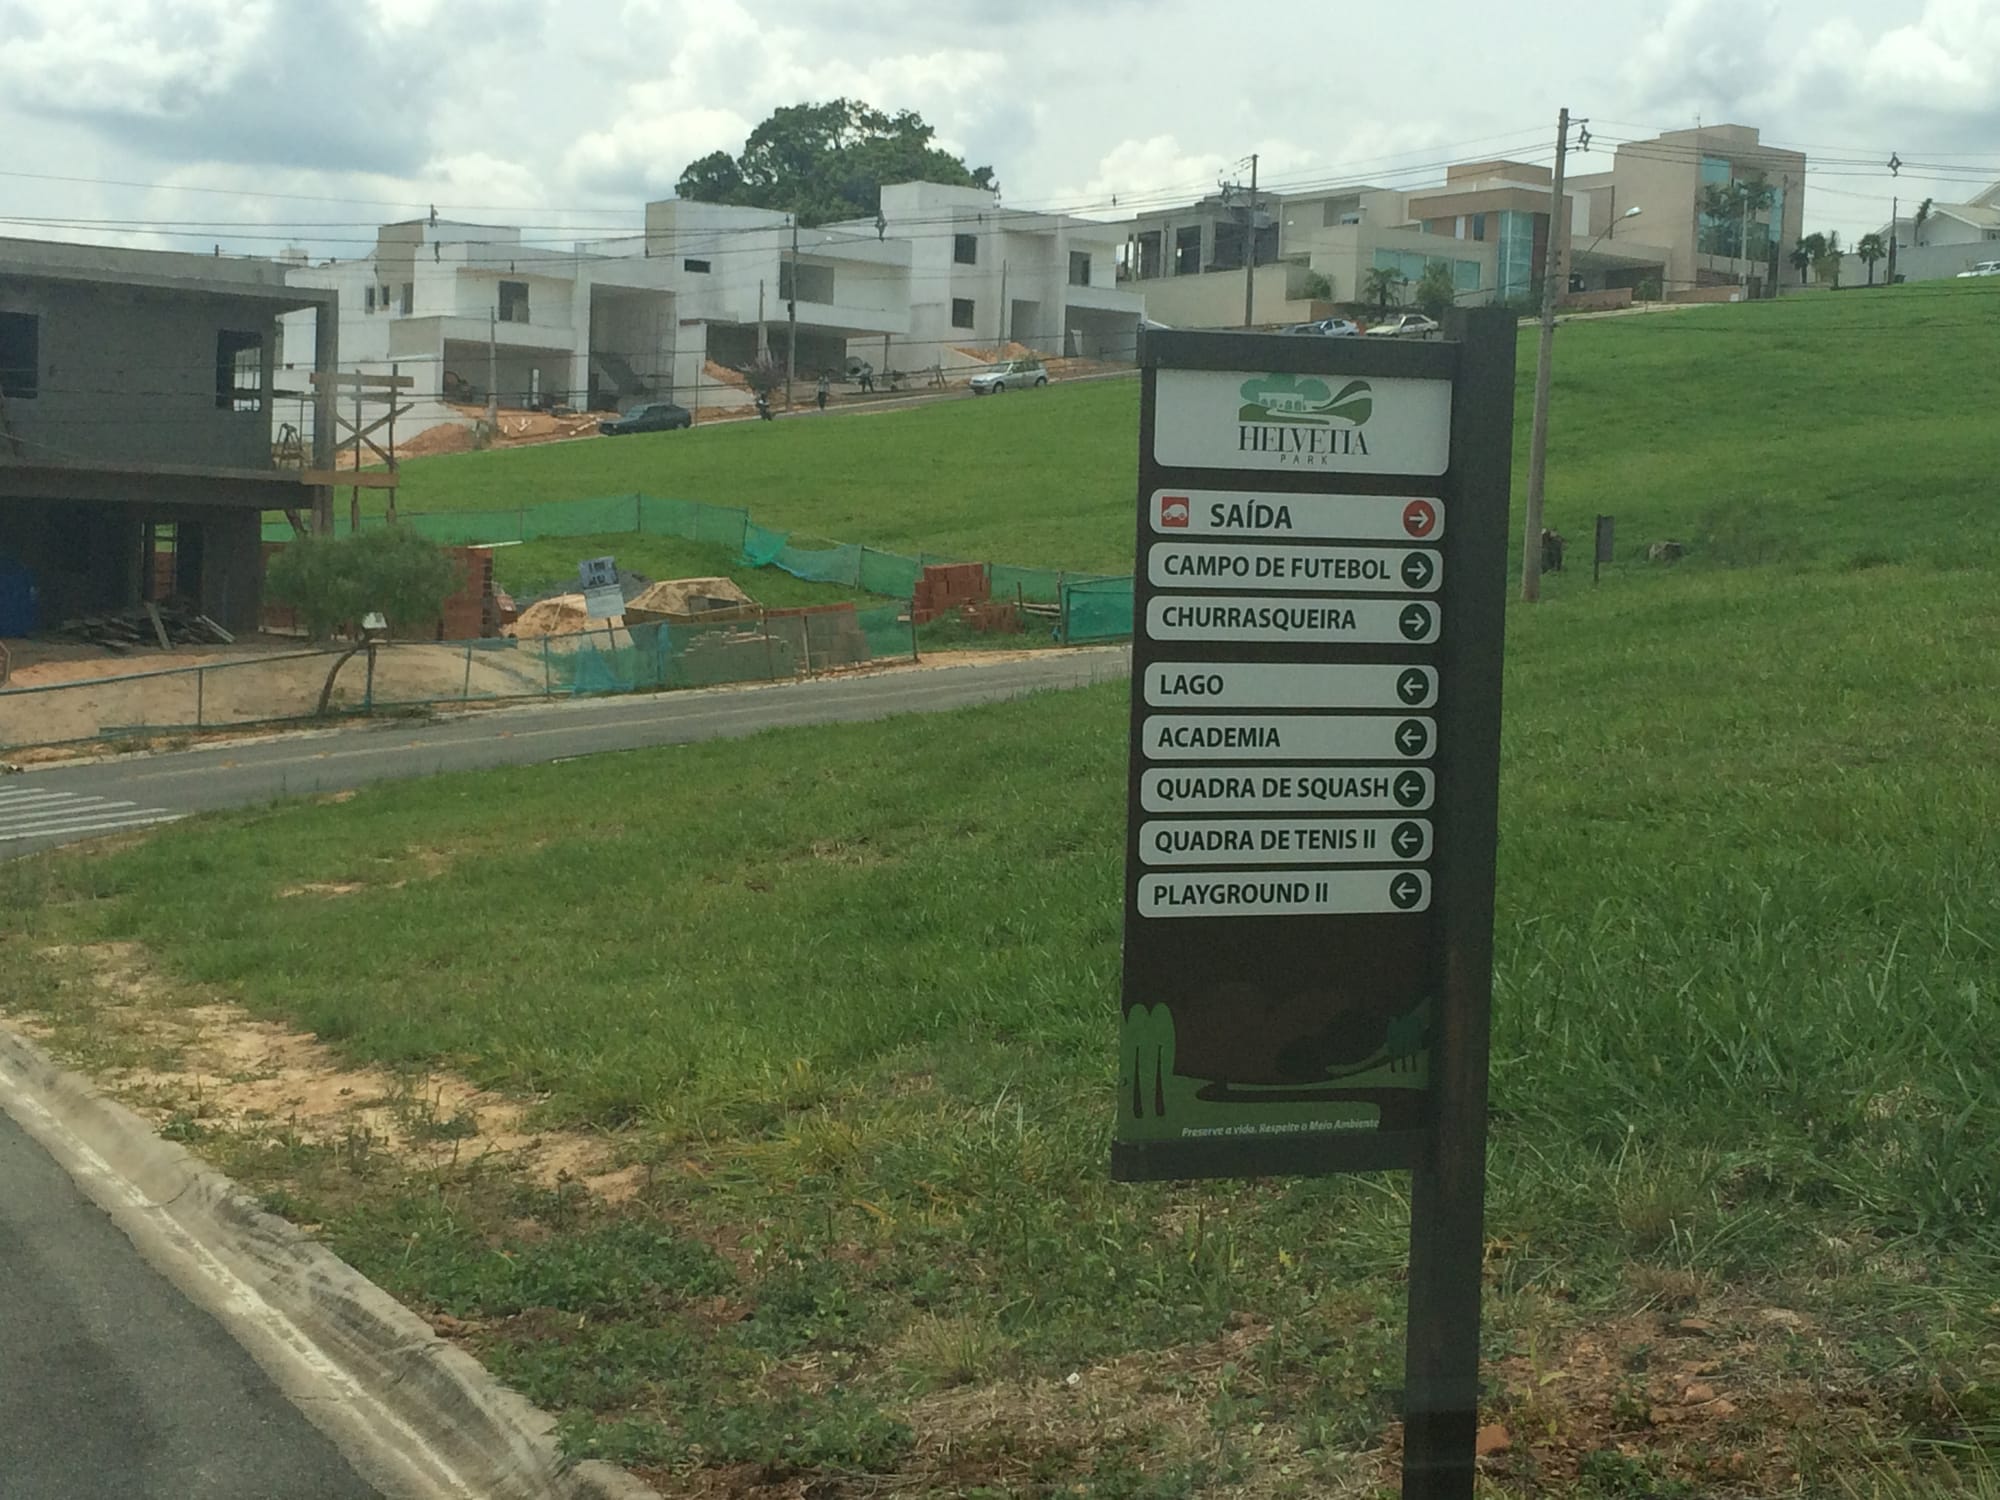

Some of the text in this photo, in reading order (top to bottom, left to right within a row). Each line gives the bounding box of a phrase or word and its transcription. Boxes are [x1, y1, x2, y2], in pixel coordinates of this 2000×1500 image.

[1238, 425, 1369, 456] HELVETIA
[1280, 453, 1328, 465] PARK
[1209, 499, 1293, 529] SAÍDA
[1163, 554, 1391, 580] CAMPO DE FUTEBOL
[1161, 606, 1356, 632] CHURRASQUEIRA
[1160, 674, 1224, 695] LAGO
[1157, 726, 1281, 748] ACADEMIA
[1156, 777, 1389, 800] QUADRA DE SQUASH
[1154, 829, 1376, 854] QUADRA DE TENIS II
[1153, 882, 1329, 906] PLAYGROUND II
[1181, 1126, 1225, 1137] Preserve
[1226, 1127, 1233, 1136] a
[1259, 1122, 1300, 1136] Respeite
[1309, 1121, 1333, 1131] Meio
[1334, 1118, 1380, 1130] Ambiente
